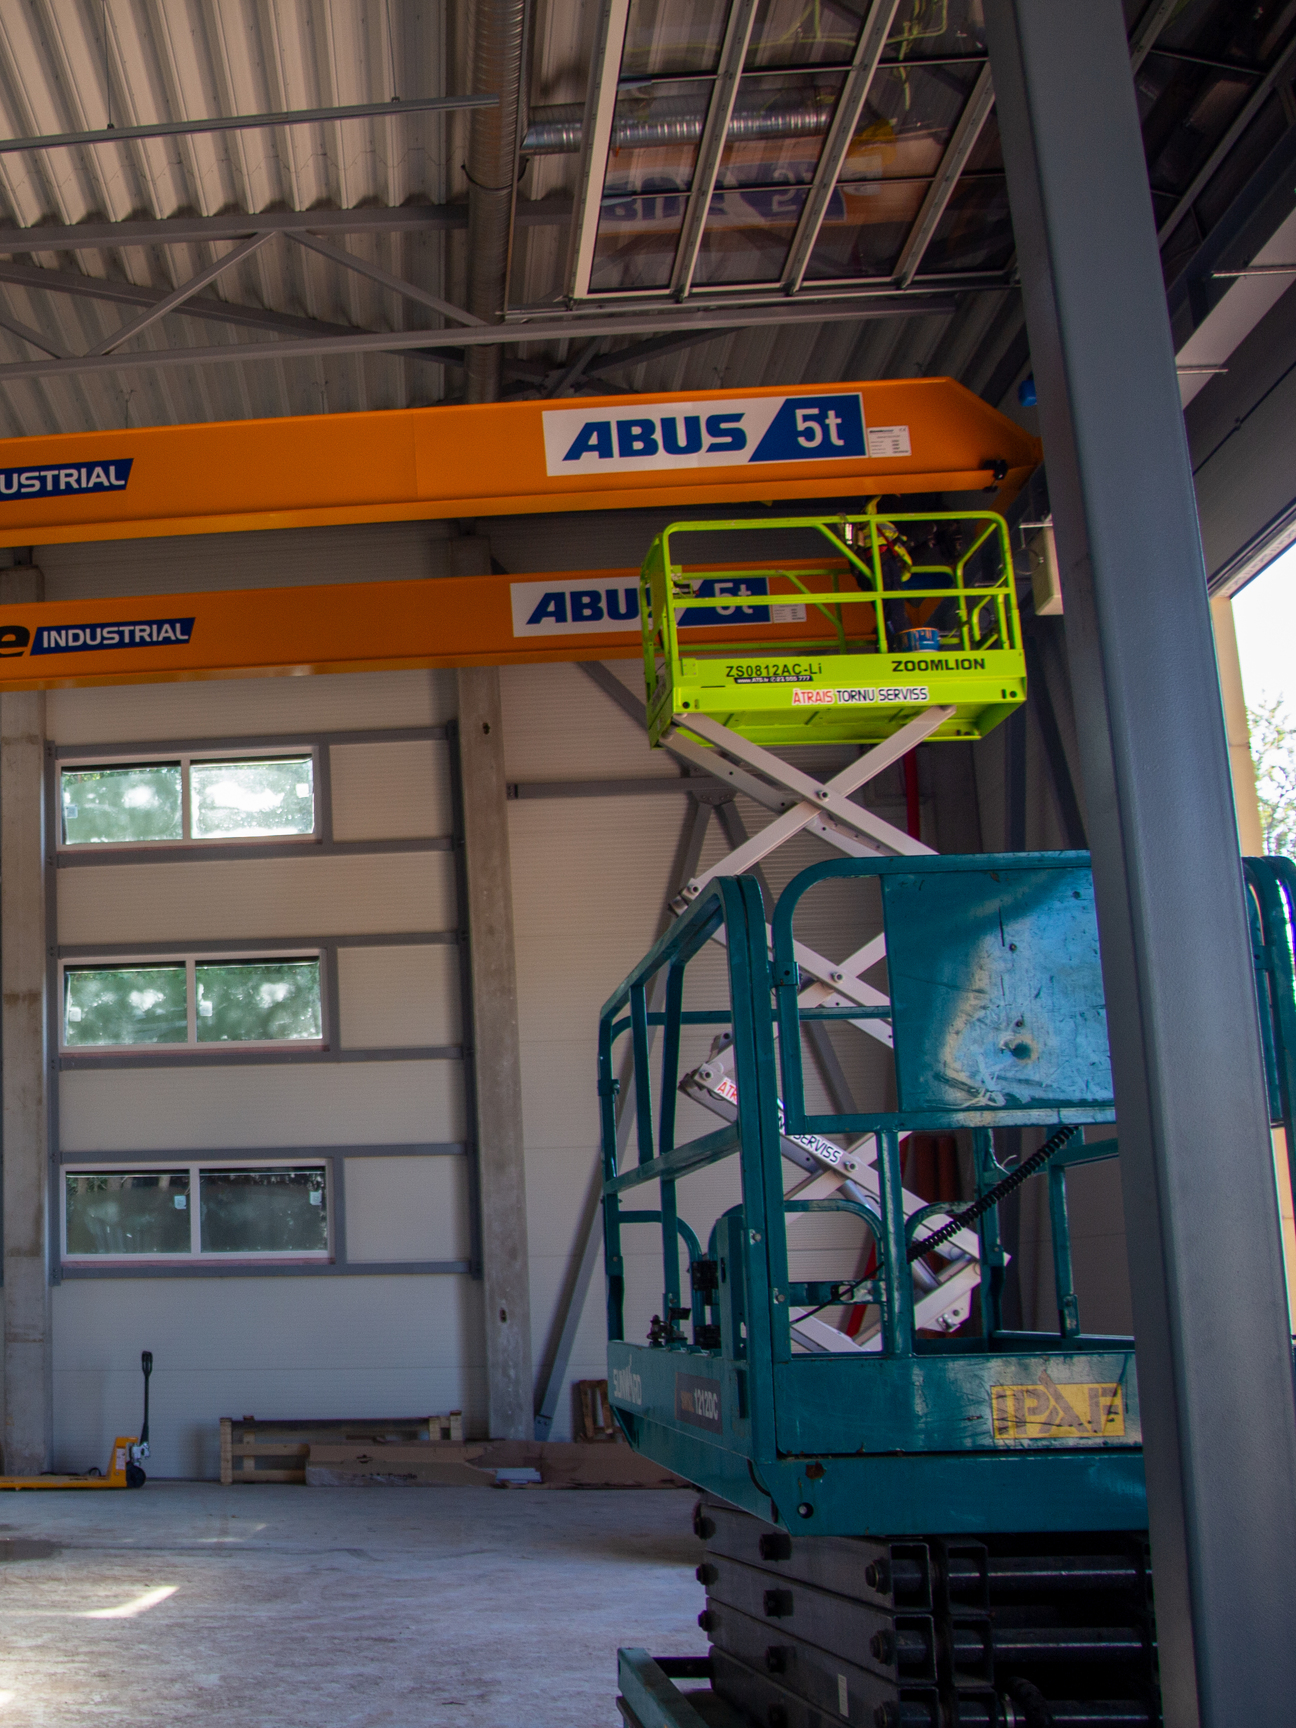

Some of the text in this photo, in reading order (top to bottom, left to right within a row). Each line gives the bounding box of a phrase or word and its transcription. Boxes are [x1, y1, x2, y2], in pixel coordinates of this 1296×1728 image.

[562, 408, 845, 461] ABUS 5t
[525, 587, 653, 625] ABU
[713, 582, 753, 616] 5t
[42, 623, 189, 648] INDUSTRIAL
[725, 662, 822, 678] ZS0812AC-Li
[891, 657, 986, 673] ZOOMLION
[793, 688, 834, 705] ĀTRAIS
[879, 687, 928, 702] SERVISS
[995, 1370, 1120, 1436] IPAF
